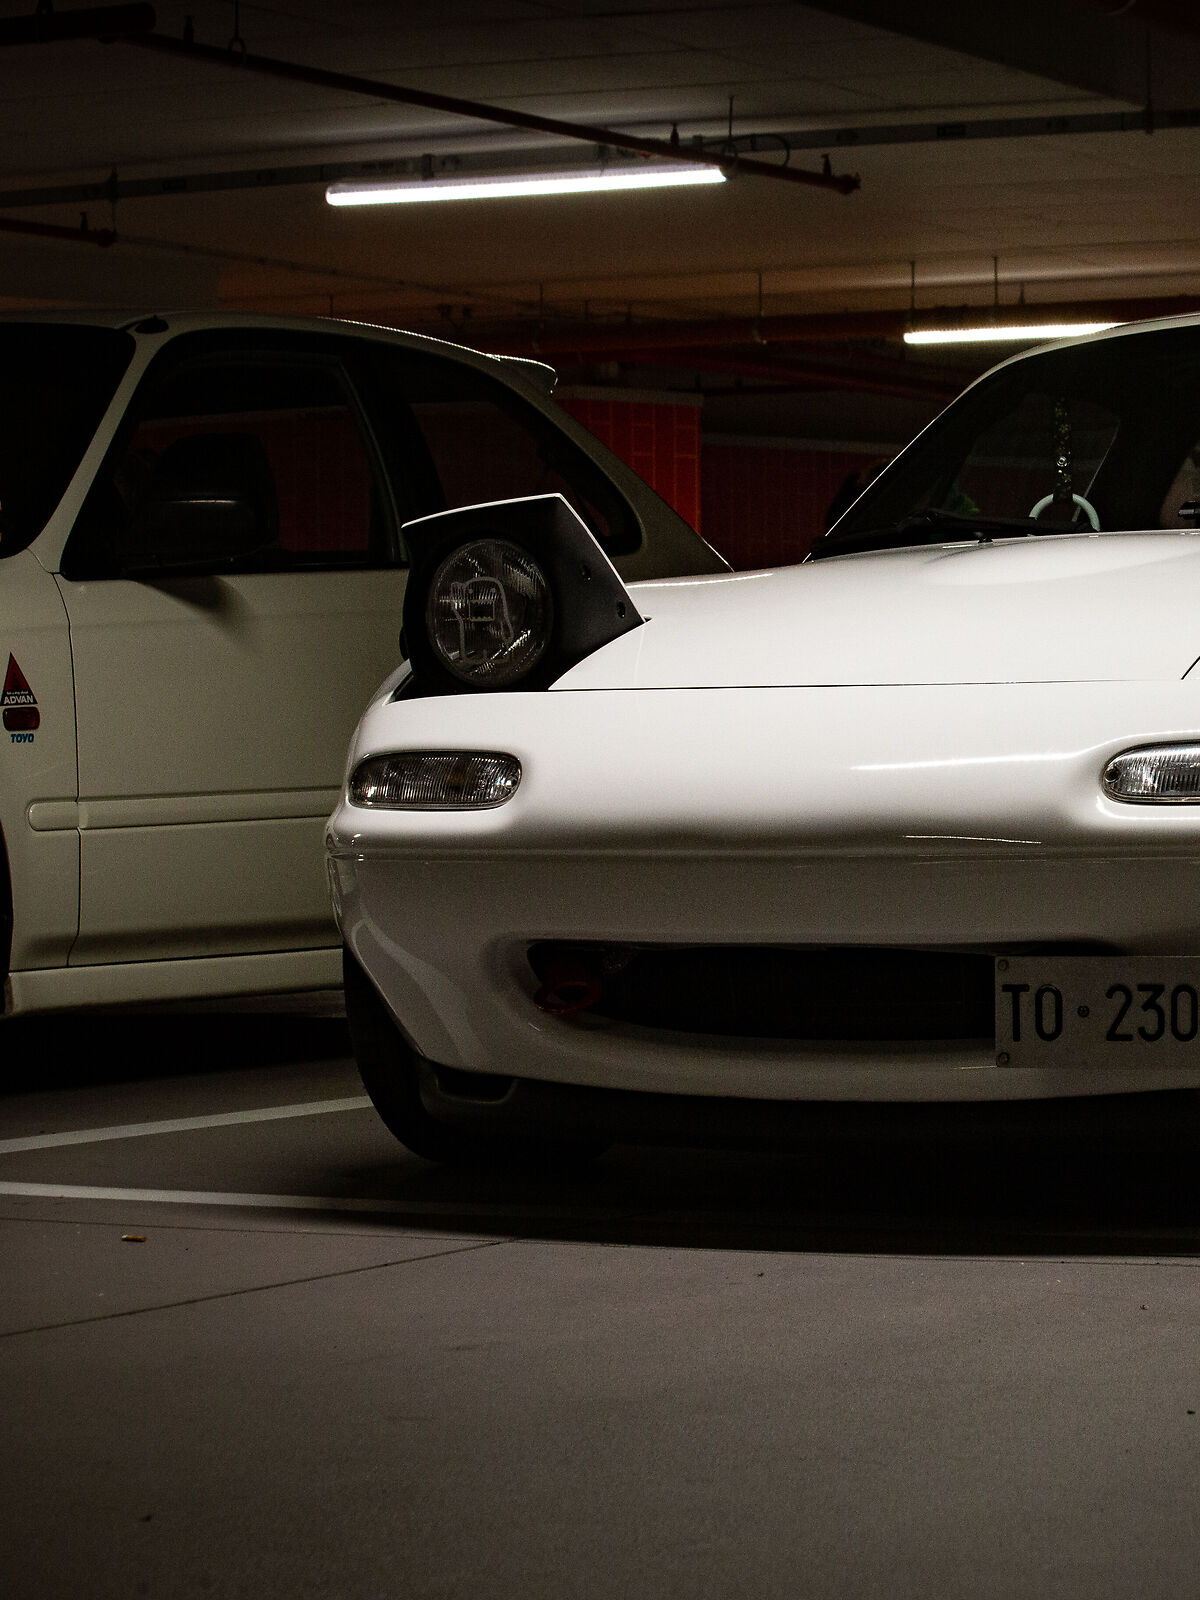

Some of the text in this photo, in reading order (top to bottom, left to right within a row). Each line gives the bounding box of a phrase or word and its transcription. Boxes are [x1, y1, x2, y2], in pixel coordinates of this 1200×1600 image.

[4, 695, 34, 705] ADVAN
[11, 733, 34, 743] TOYO
[1001, 983, 1063, 1042] TO
